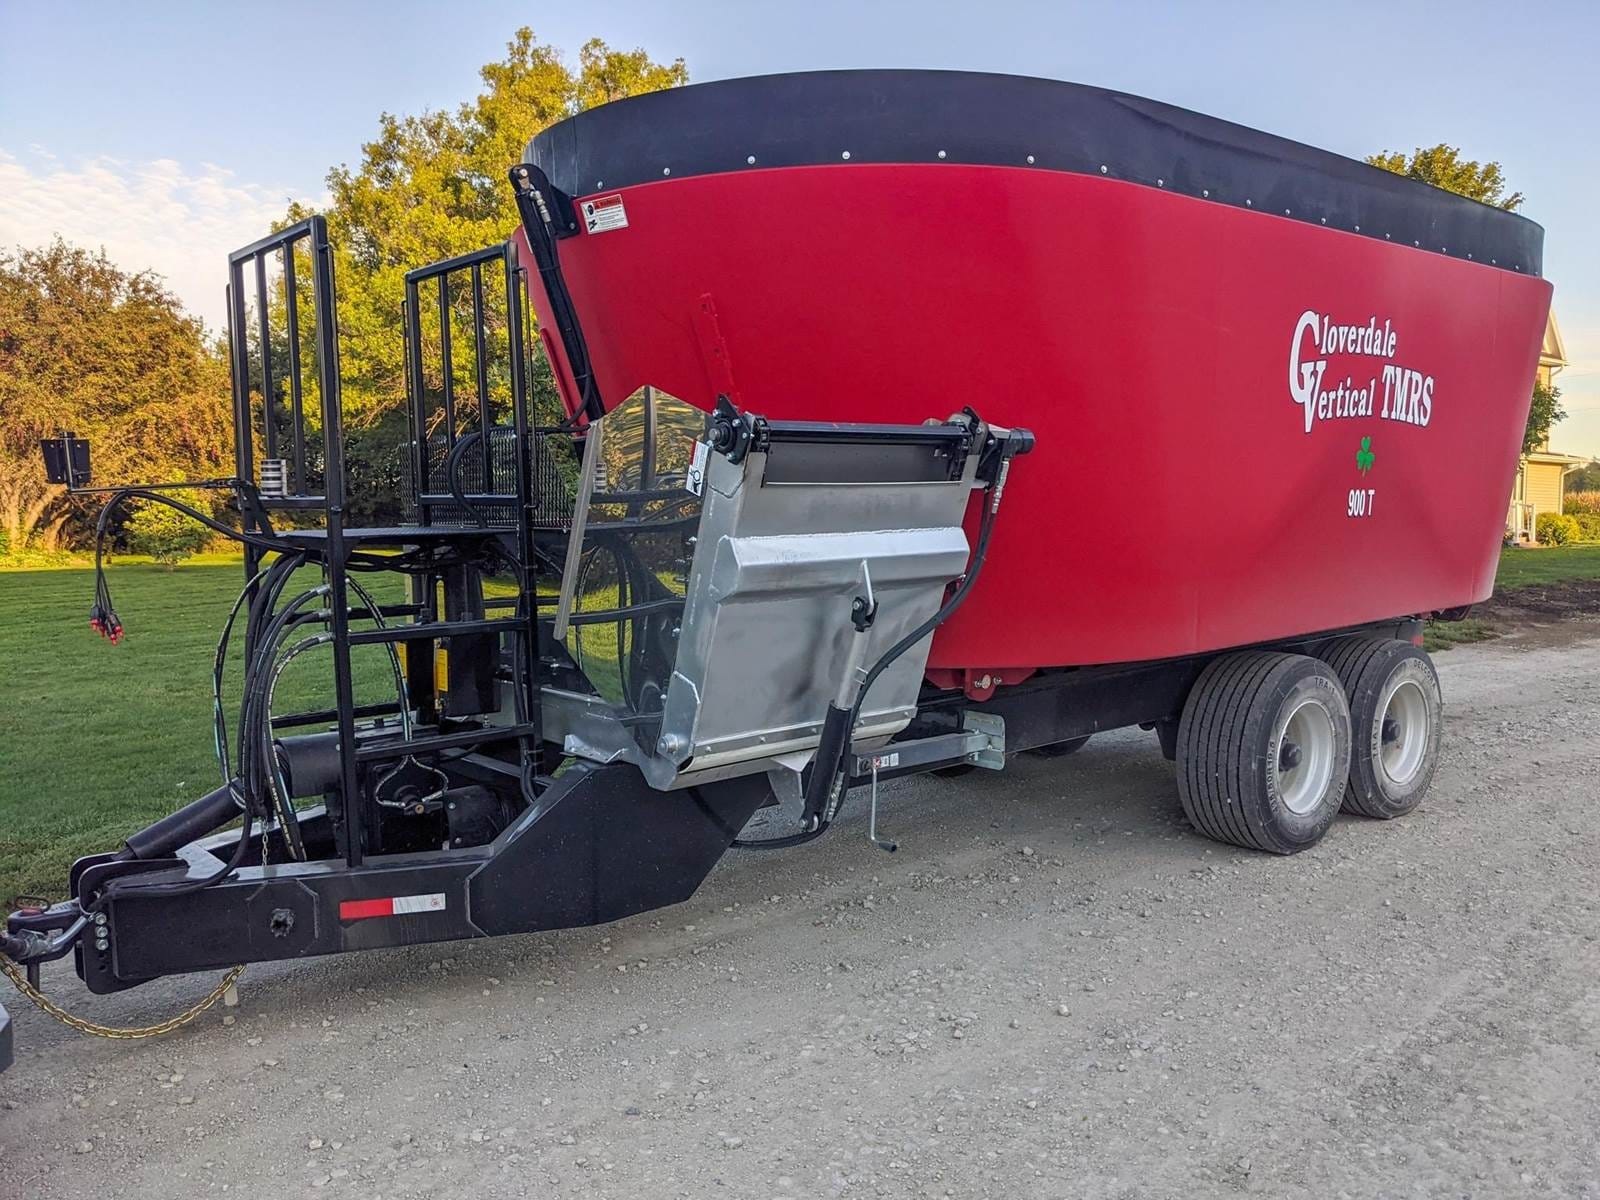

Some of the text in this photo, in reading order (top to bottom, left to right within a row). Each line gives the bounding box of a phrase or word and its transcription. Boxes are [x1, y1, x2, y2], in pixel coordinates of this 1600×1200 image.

[1289, 310, 1397, 404] Cloverdale
[1301, 360, 1434, 433] Vertical TMRS
[1348, 489, 1375, 516] 900 T
